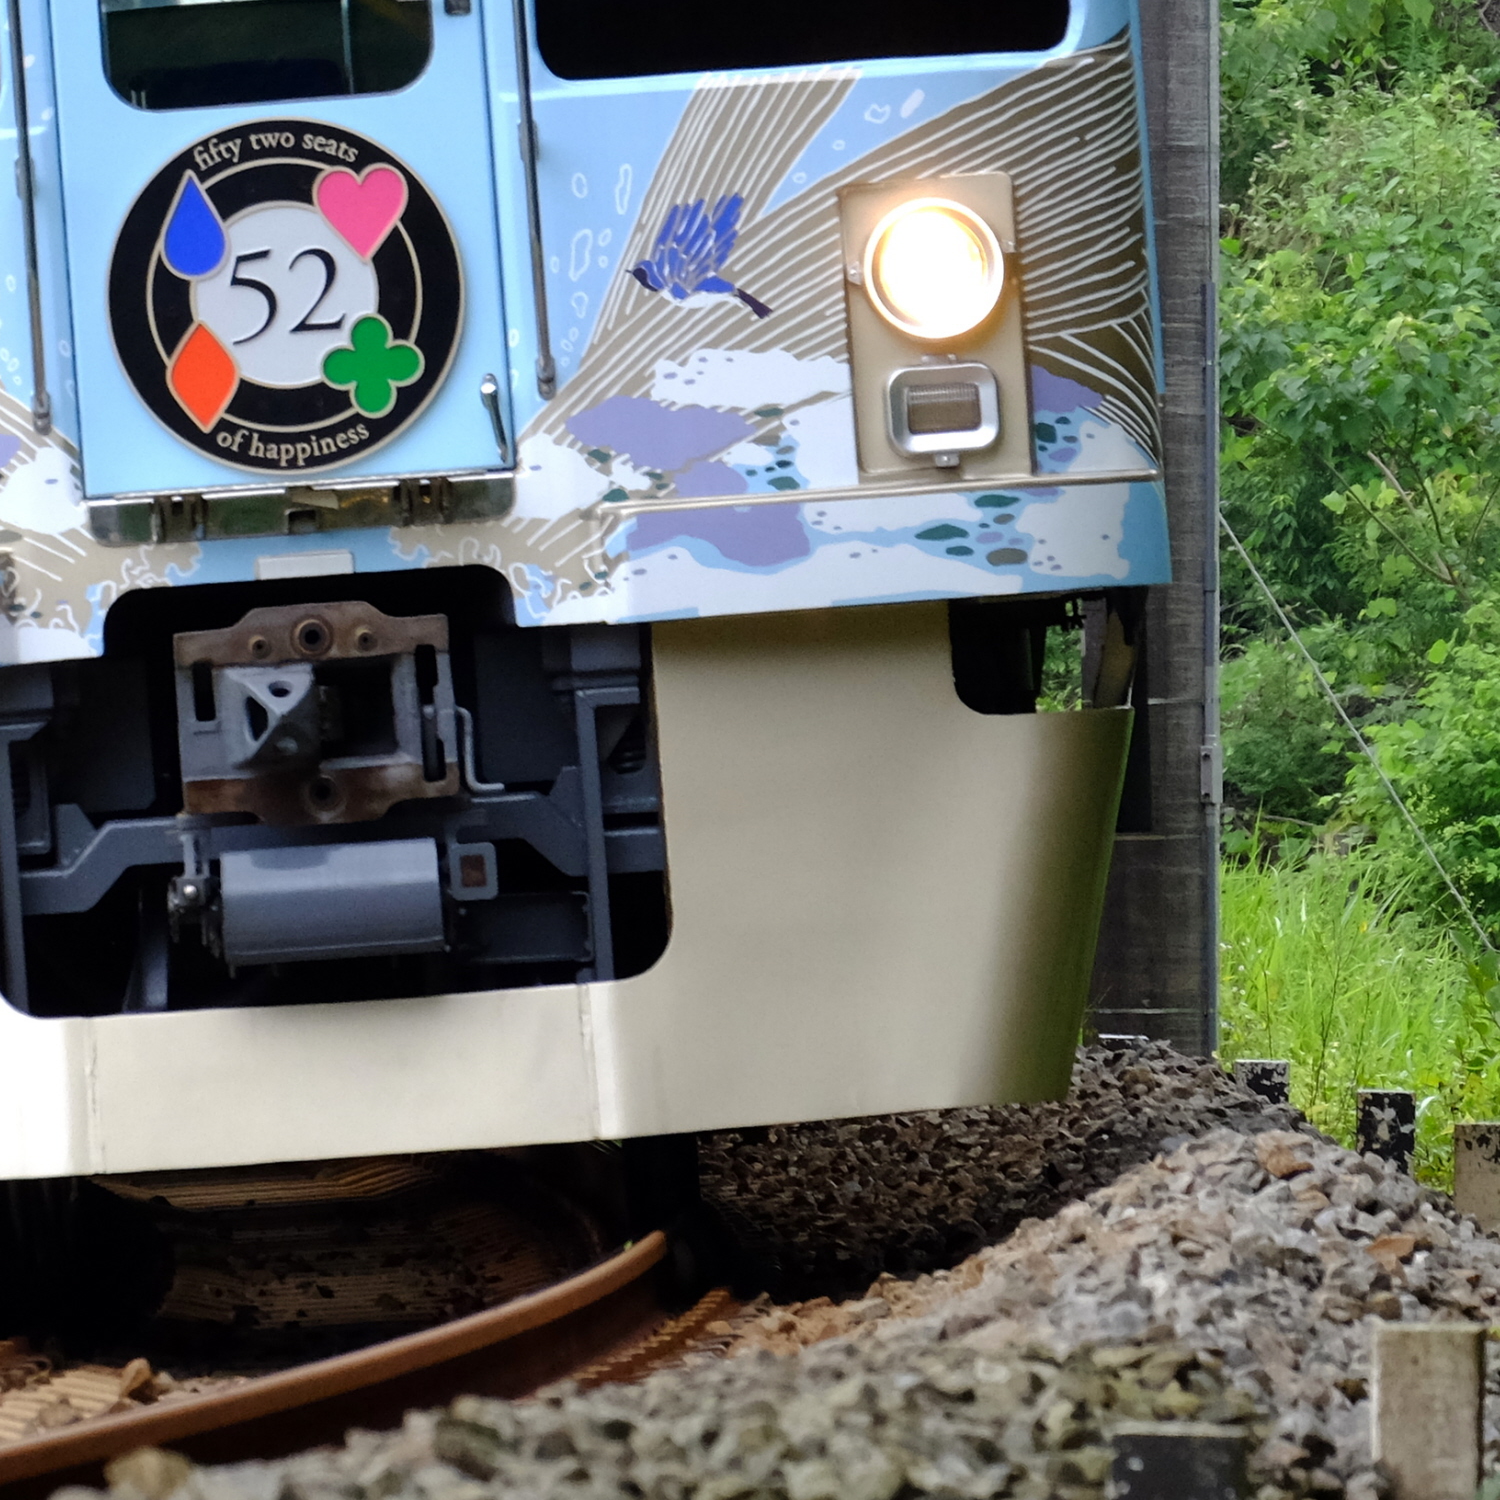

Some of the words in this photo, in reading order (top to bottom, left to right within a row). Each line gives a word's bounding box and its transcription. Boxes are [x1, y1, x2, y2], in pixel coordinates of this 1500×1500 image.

[193, 136, 242, 171] fifty
[249, 131, 295, 151] two
[302, 132, 359, 163] seats
[229, 248, 347, 346] 52
[216, 430, 249, 452] of
[249, 423, 370, 467] happiness
